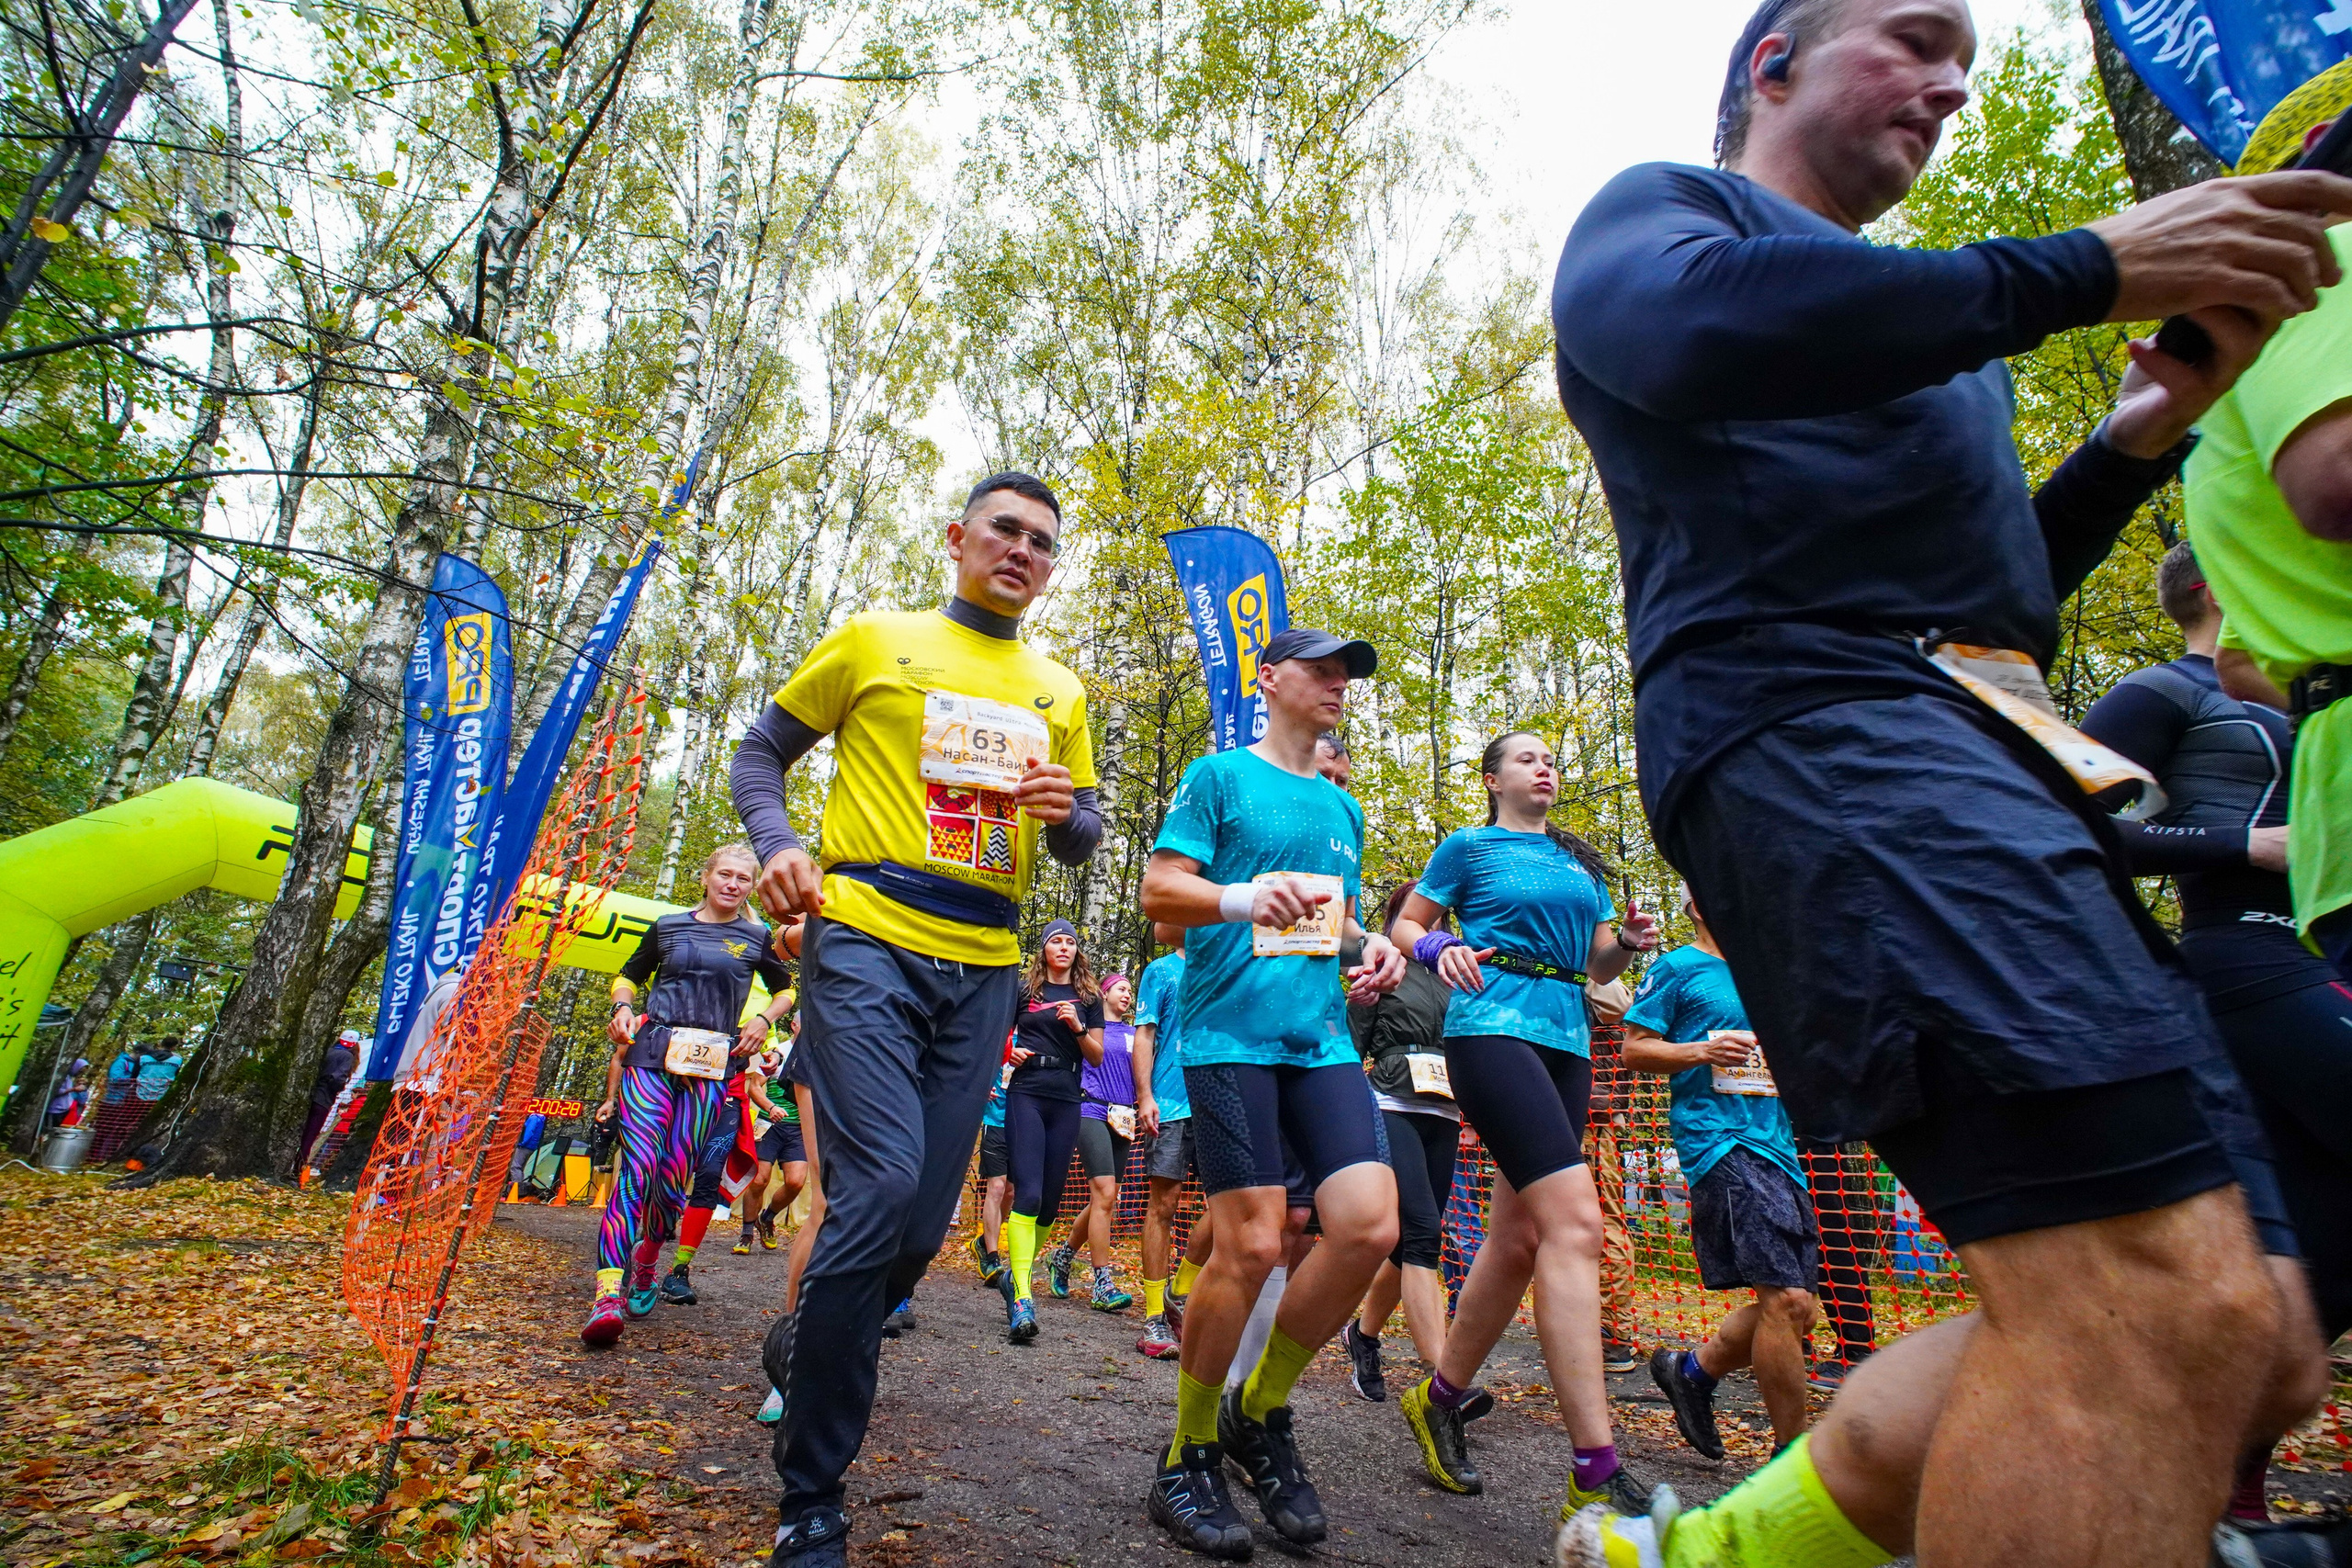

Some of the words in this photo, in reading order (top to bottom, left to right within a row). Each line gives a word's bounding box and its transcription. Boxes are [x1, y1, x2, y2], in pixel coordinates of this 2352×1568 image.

[972, 728, 1008, 753] 63
[2143, 825, 2206, 836] KIPSTA
[924, 863, 971, 878] MOSCOW
[972, 871, 1015, 885] MARATHON
[2239, 910, 2298, 929] 2X
[1294, 923, 1321, 933] Илья
[693, 1044, 710, 1057] 37
